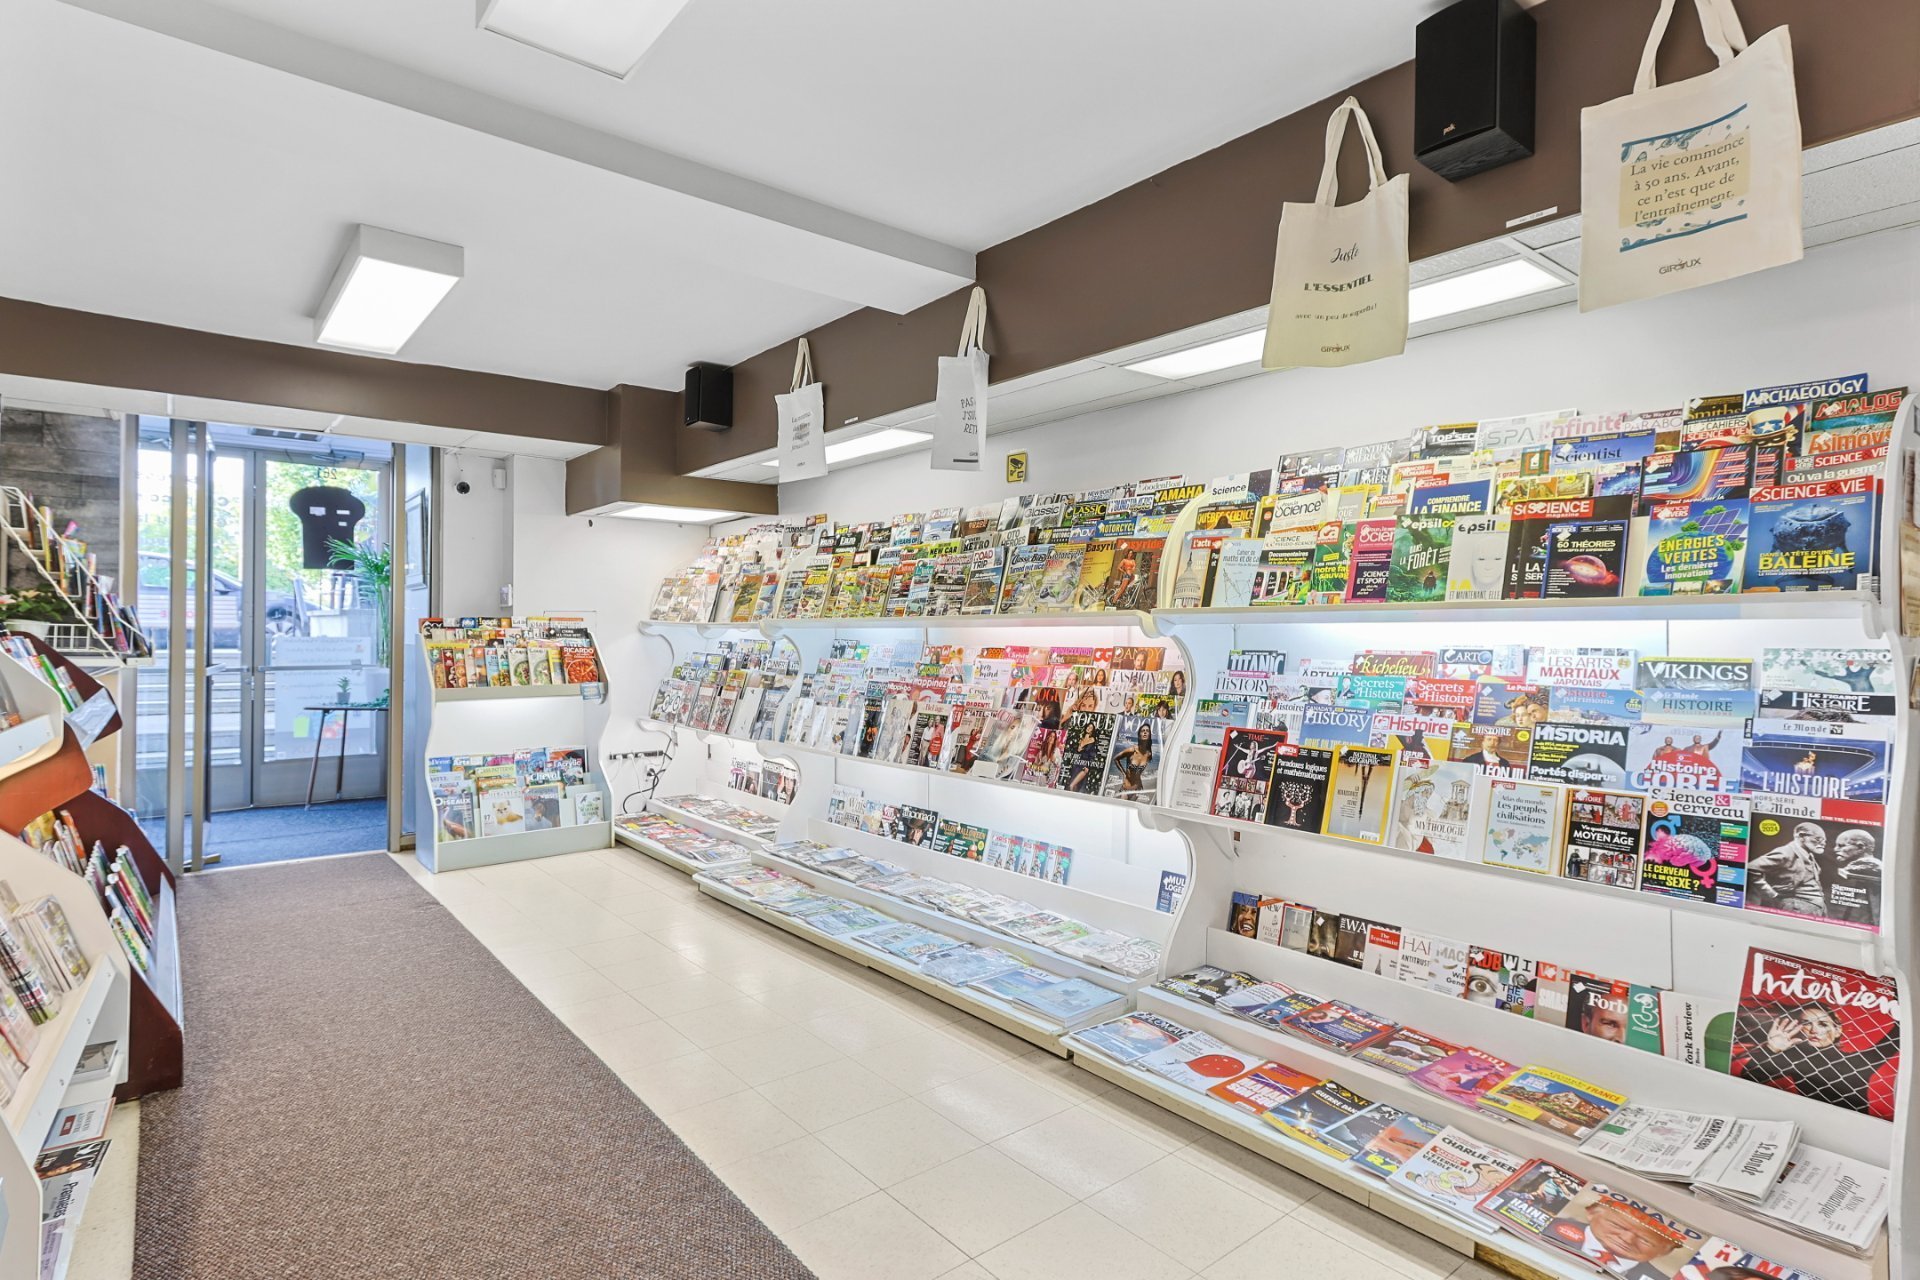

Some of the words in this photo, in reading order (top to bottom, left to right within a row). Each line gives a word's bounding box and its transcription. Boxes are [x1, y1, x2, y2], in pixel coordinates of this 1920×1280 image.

[1630, 164, 1647, 177] La
[1651, 158, 1669, 171] vie
[1673, 135, 1745, 166] commence
[1633, 180, 1641, 191] à
[1645, 178, 1660, 193] 50
[1663, 170, 1690, 184] ans.
[1695, 157, 1740, 177] Avant,
[1637, 197, 1651, 207] ce
[1654, 188, 1687, 203] n'est
[1690, 182, 1715, 200] que
[1719, 172, 1735, 187] de
[1303, 273, 1374, 292] L'ESSENTIEL
[1747, 378, 1865, 407] ARCHAEOLOGY
[1706, 417, 1747, 431] CAHIERS
[1688, 430, 1724, 442] SCIENCE
[1554, 446, 1622, 464] Scientist
[1815, 452, 1863, 468] SCIENCE
[1872, 447, 1889, 459] VIE
[1788, 471, 1805, 484] Où
[1807, 471, 1823, 482] va
[1824, 468, 1835, 480] la
[1212, 482, 1248, 497] Science
[1760, 484, 1828, 503] SCIENCE
[1842, 478, 1866, 494] VIE
[1428, 492, 1471, 505] COMPRENDRE
[1431, 500, 1482, 514] FINANCE
[1275, 499, 1321, 520] Science
[1527, 500, 1590, 515] SCIENCE
[1557, 540, 1570, 549] 60
[1572, 538, 1617, 549] THÉORIES
[1658, 533, 1725, 553] ÉNERGIES
[1407, 546, 1439, 572] FORÊT
[1664, 547, 1718, 565] VERTES
[1758, 551, 1856, 571] BALEINE
[1525, 564, 1540, 572] LA
[1661, 564, 1676, 573] Les
[1678, 560, 1719, 571] dernières
[1665, 569, 1714, 581] innovations
[564, 647, 595, 656] RICARDO
[1362, 655, 1419, 677] Richelieu
[1548, 656, 1573, 668] LES
[1577, 656, 1613, 669] ARTS
[1540, 667, 1620, 681] MARTIAUX
[1647, 662, 1749, 682] VIKINGS
[1353, 679, 1395, 691] Secrets
[1418, 680, 1464, 693] Secrets
[1506, 684, 1517, 692] Le
[1518, 684, 1537, 693] Point
[1553, 678, 1602, 689] JAPONAIS
[1353, 688, 1404, 701] d'Histoire
[1419, 691, 1474, 705] d'Histoire
[1792, 691, 1871, 713] HISTOIRE
[1822, 693, 1859, 702] FIGARO
[1663, 699, 1734, 713] HISTOIRE
[1072, 711, 1115, 730] VOGUE
[1389, 715, 1450, 736] Histoire
[1783, 722, 1794, 733] Le
[1795, 723, 1828, 735] Monde
[1248, 733, 1265, 742] TIME
[1535, 724, 1626, 747] HISTORIA
[1531, 764, 1567, 778] Portés
[1568, 769, 1618, 784] disparus
[1651, 759, 1717, 776] Histoire
[1762, 771, 1851, 801] L'HISTOIRE
[1523, 797, 1546, 807] monde
[1651, 788, 1714, 806] Sience
[1497, 801, 1512, 811] Les
[1512, 803, 1548, 816] peuples
[1673, 802, 1745, 820] cerveau
[1770, 801, 1817, 818] Monde
[1496, 812, 1546, 825] civilisations
[1415, 819, 1465, 837] MYTHOLOGIE
[1573, 831, 1612, 844] MOYEN
[1613, 832, 1635, 847] ÂGE
[1644, 863, 1653, 873] LE
[1653, 865, 1690, 879] CERVEAU
[1665, 876, 1692, 891] SEXE
[1762, 953, 1802, 970] SEPTEMBER
[1506, 993, 1524, 1006] BIG
[1588, 991, 1629, 1014] Forb
[1330, 1004, 1348, 1018] Le
[1350, 1010, 1383, 1031] Point
[1684, 1001, 1694, 1038] Review
[1585, 1084, 1622, 1103] FRANCE
[1441, 1136, 1489, 1162] CHARLIE
[1740, 1148, 1776, 1179] Monde
